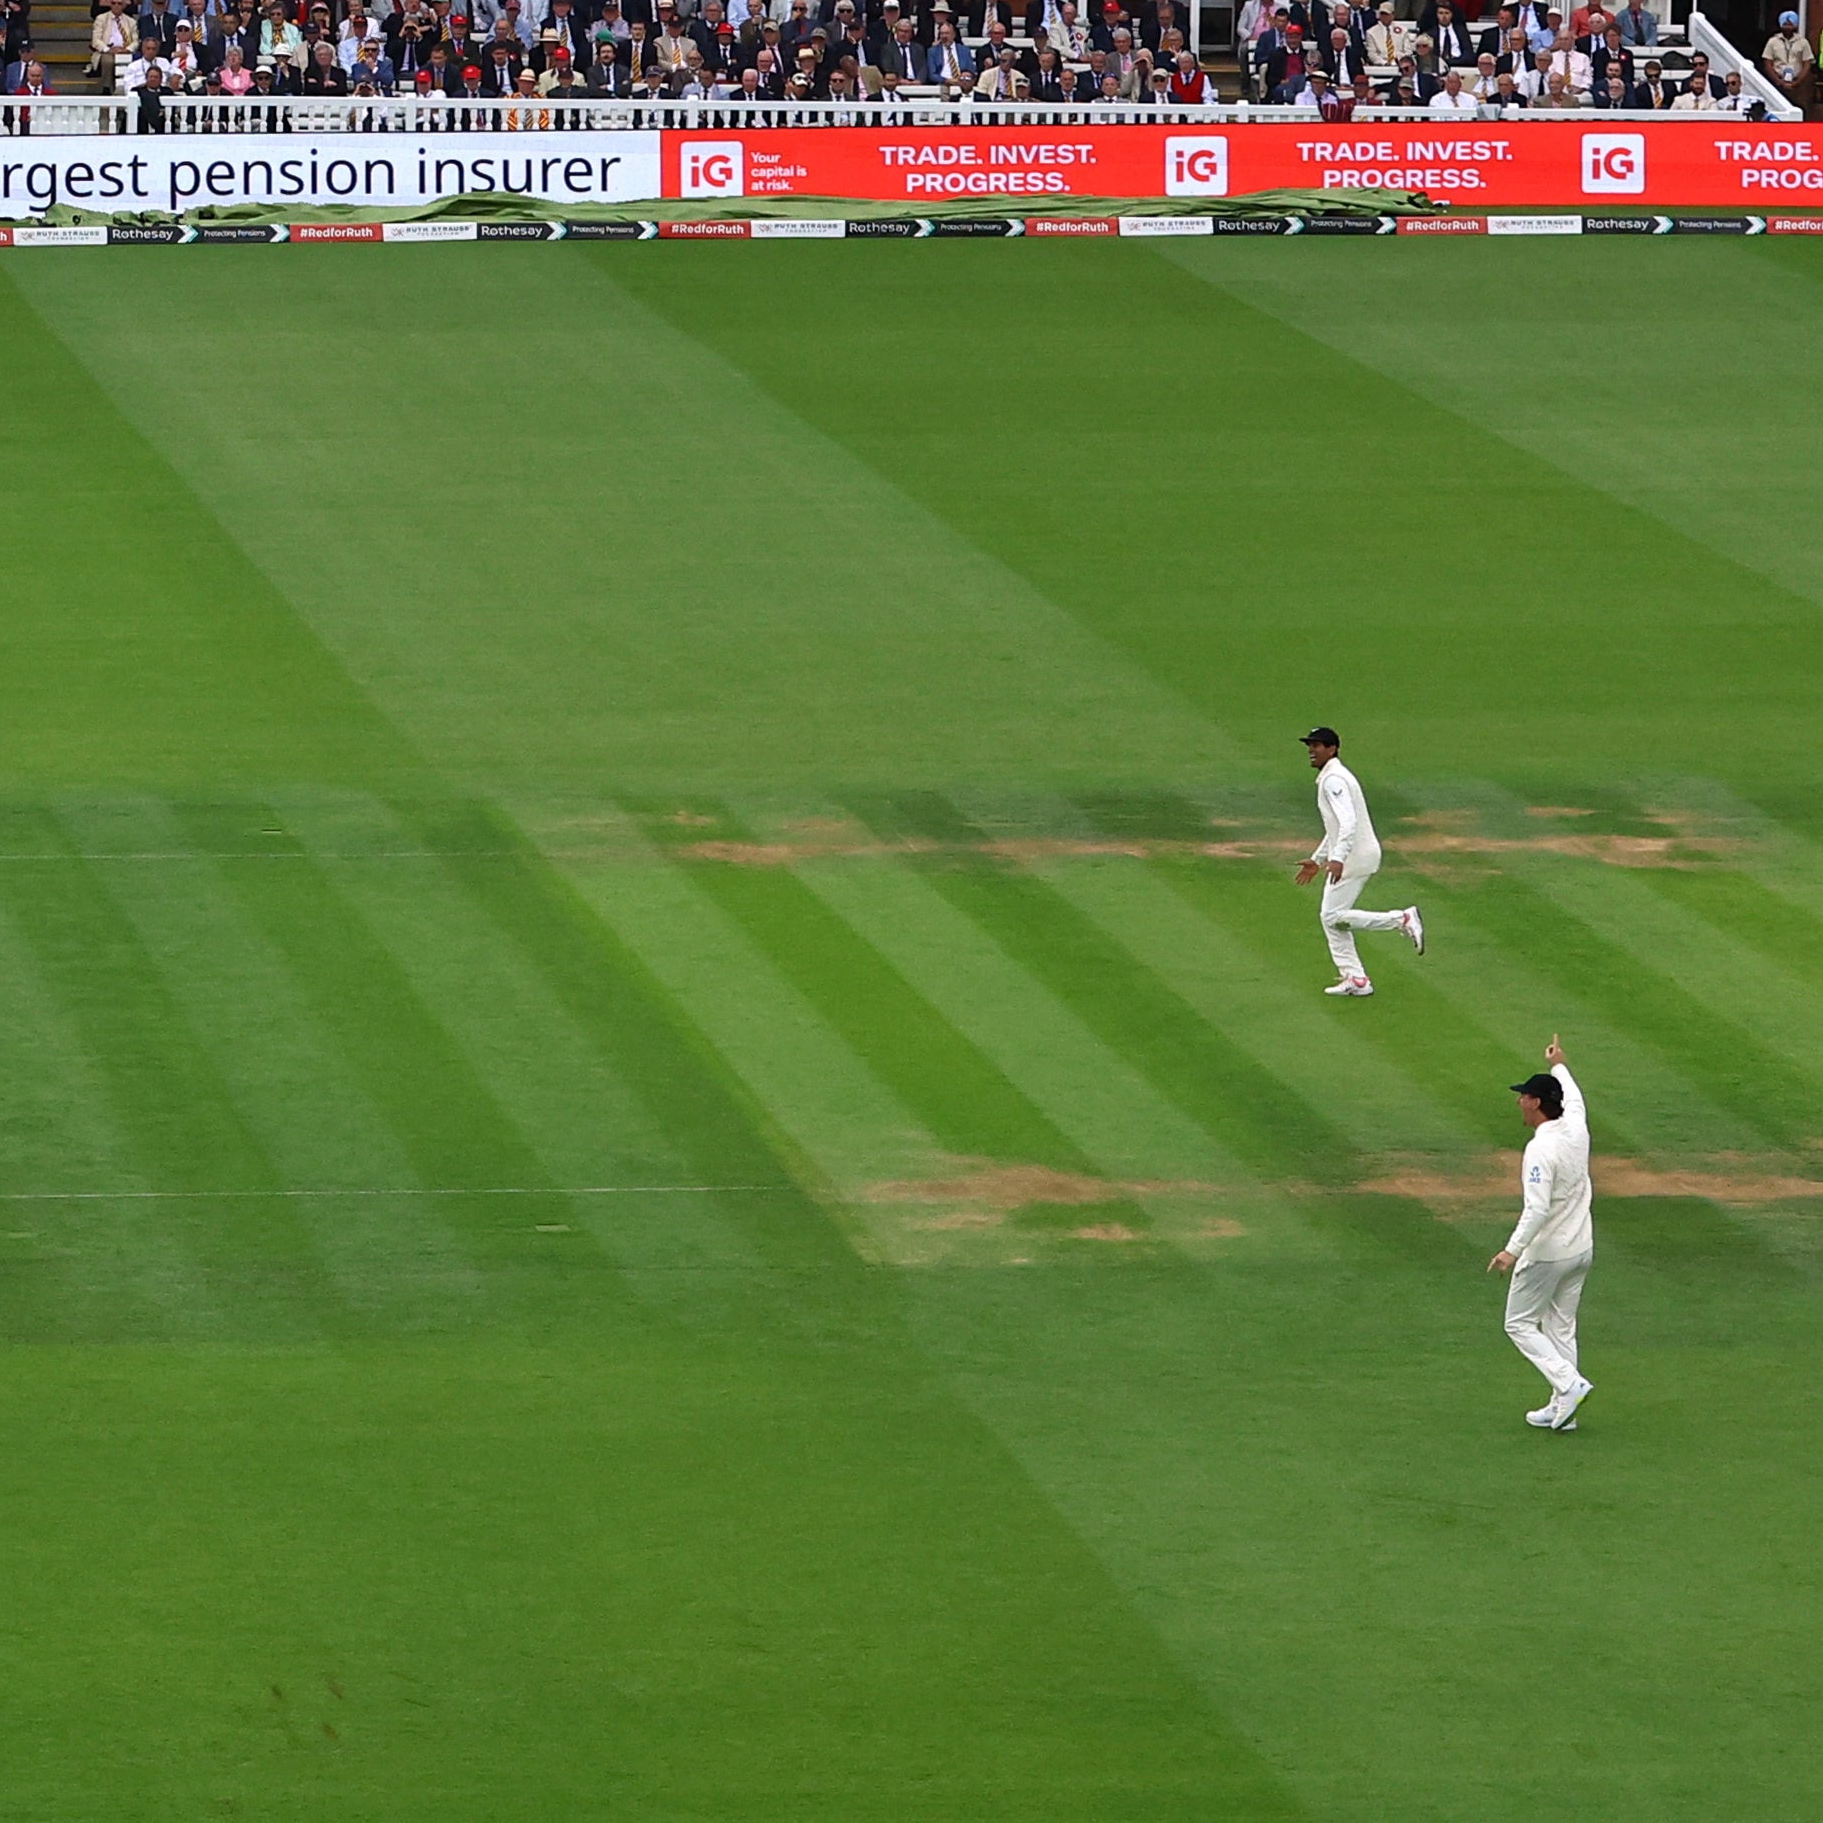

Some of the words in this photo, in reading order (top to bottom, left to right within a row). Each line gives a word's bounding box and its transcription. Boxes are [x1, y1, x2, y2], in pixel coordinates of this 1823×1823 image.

[751, 152, 781, 163] Your
[879, 145, 983, 165] TRADE.
[990, 144, 1097, 165] INVEST.
[1296, 141, 1400, 162] TRADE.
[1406, 140, 1513, 161] INVEST.
[1714, 141, 1819, 161] TRADE.
[751, 165, 795, 179] capital
[796, 165, 807, 177] is
[170, 149, 394, 212] pension
[419, 148, 621, 195] insurer
[751, 180, 765, 191] at
[766, 179, 790, 191] risk.
[906, 171, 1071, 193] PROGRESS.
[1323, 168, 1487, 190] PROGRESS.
[671, 223, 744, 234] #RedforRuth
[849, 222, 910, 235] Rothesay
[1036, 221, 1109, 233] #RedforRuth
[1218, 220, 1280, 231] Rothesay
[1406, 220, 1479, 231] #RedforRuth
[1586, 218, 1649, 231] Rothesay
[112, 228, 174, 241] Rothesay
[299, 227, 373, 238] #RedforRuth
[481, 225, 543, 238] Rothesay
